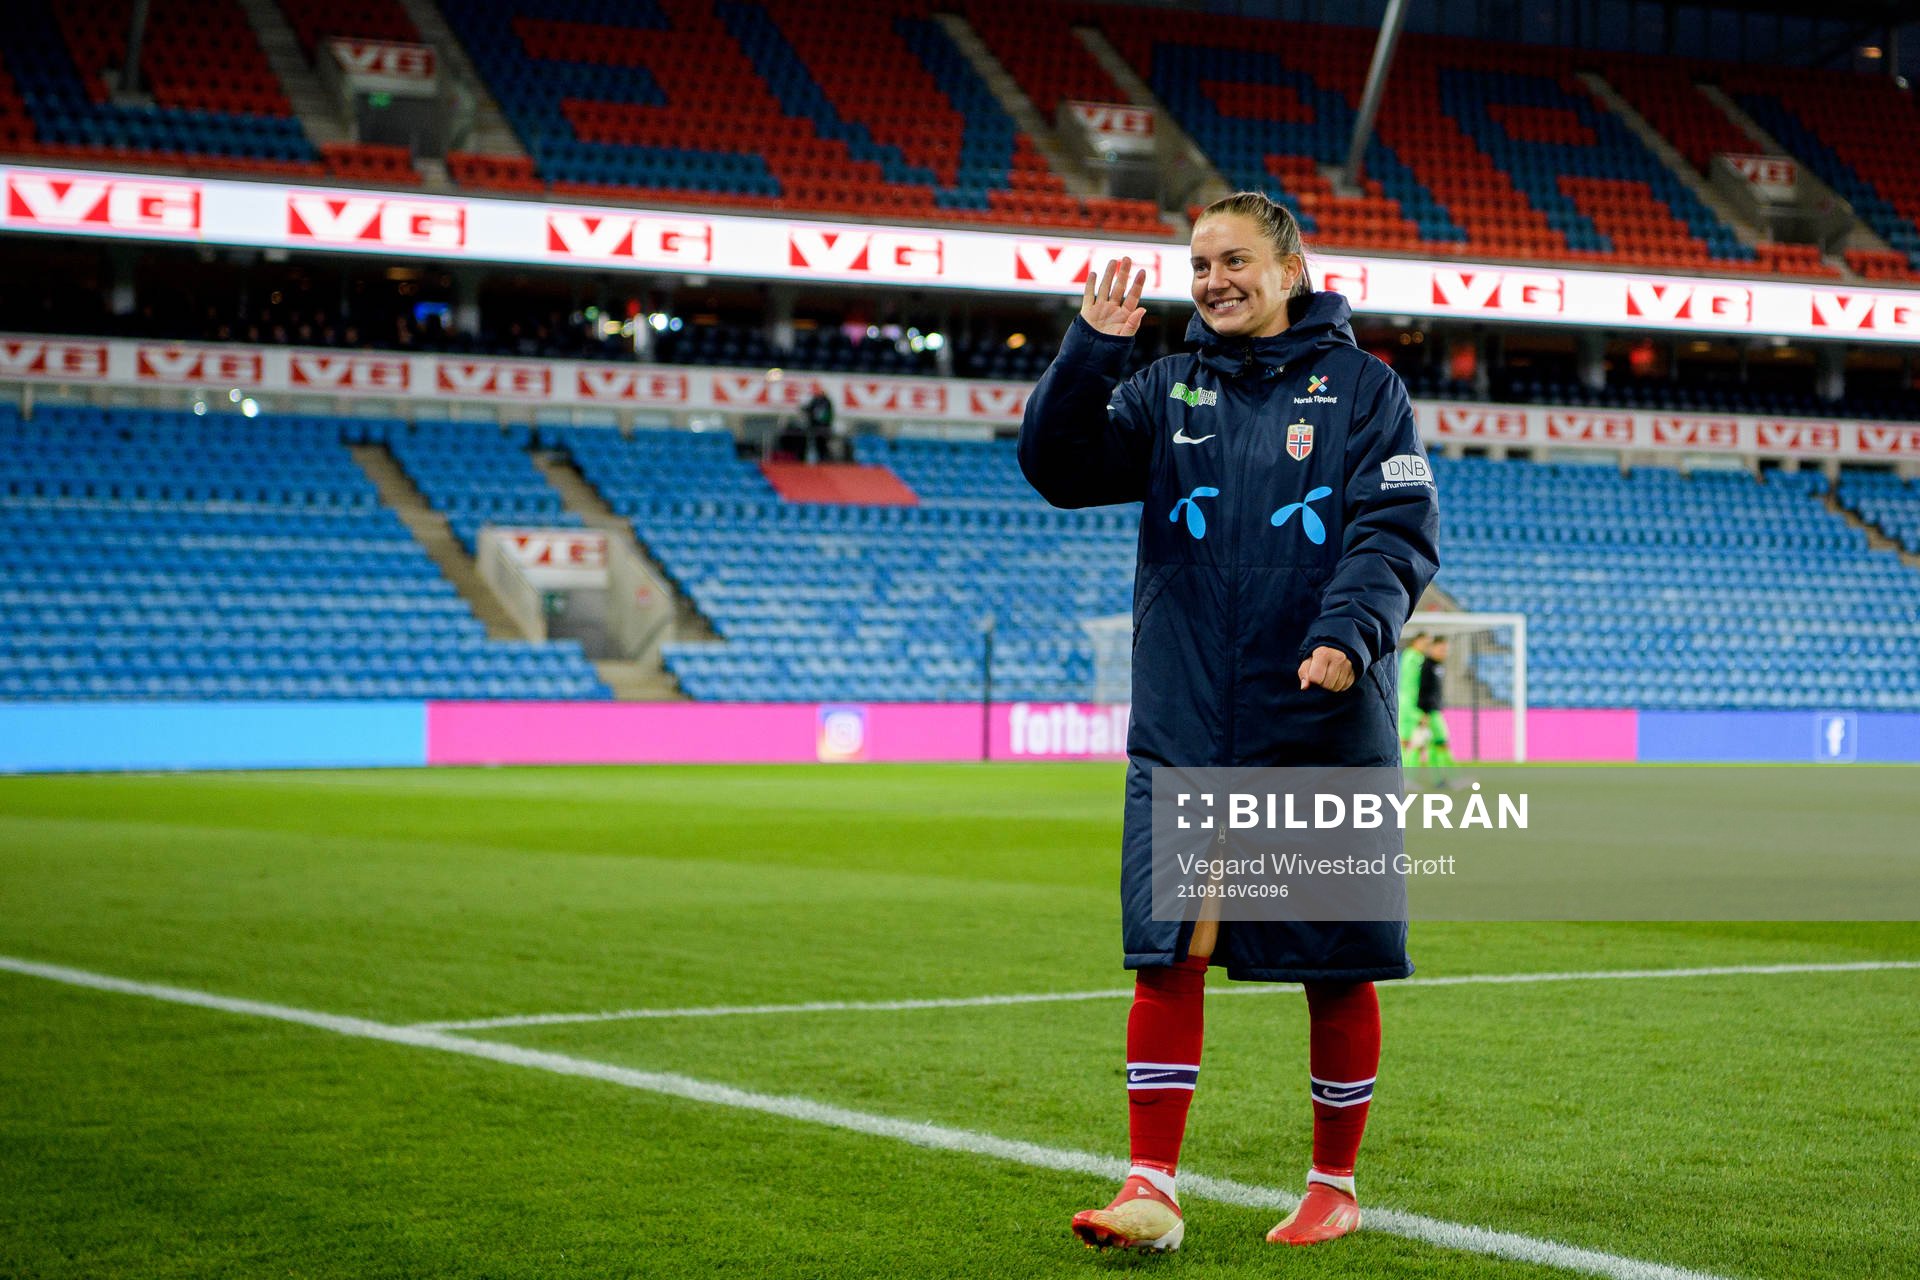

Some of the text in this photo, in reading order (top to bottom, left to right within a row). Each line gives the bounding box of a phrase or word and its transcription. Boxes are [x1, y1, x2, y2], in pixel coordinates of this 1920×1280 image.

[331, 40, 436, 78] VG
[1071, 104, 1152, 137] VG
[1726, 157, 1794, 186] VG
[9, 173, 199, 233] VG
[289, 194, 465, 250] VG
[548, 213, 712, 264] VG
[790, 230, 943, 277] VG
[1433, 270, 1564, 312] VG
[1627, 284, 1751, 323] VG
[1812, 293, 1920, 331] VG
[0, 342, 107, 378] VG
[137, 347, 261, 384] VG
[291, 355, 409, 390] VG
[437, 363, 551, 396] VG
[577, 370, 688, 401] VG
[845, 383, 946, 413] VG
[1314, 395, 1337, 404] Tipping
[1438, 409, 1526, 437] VG
[1546, 414, 1633, 443] VG
[1653, 419, 1738, 446] VG
[1757, 424, 1839, 451] VG
[1388, 454, 1426, 480] DNB
[497, 533, 607, 567] VG
